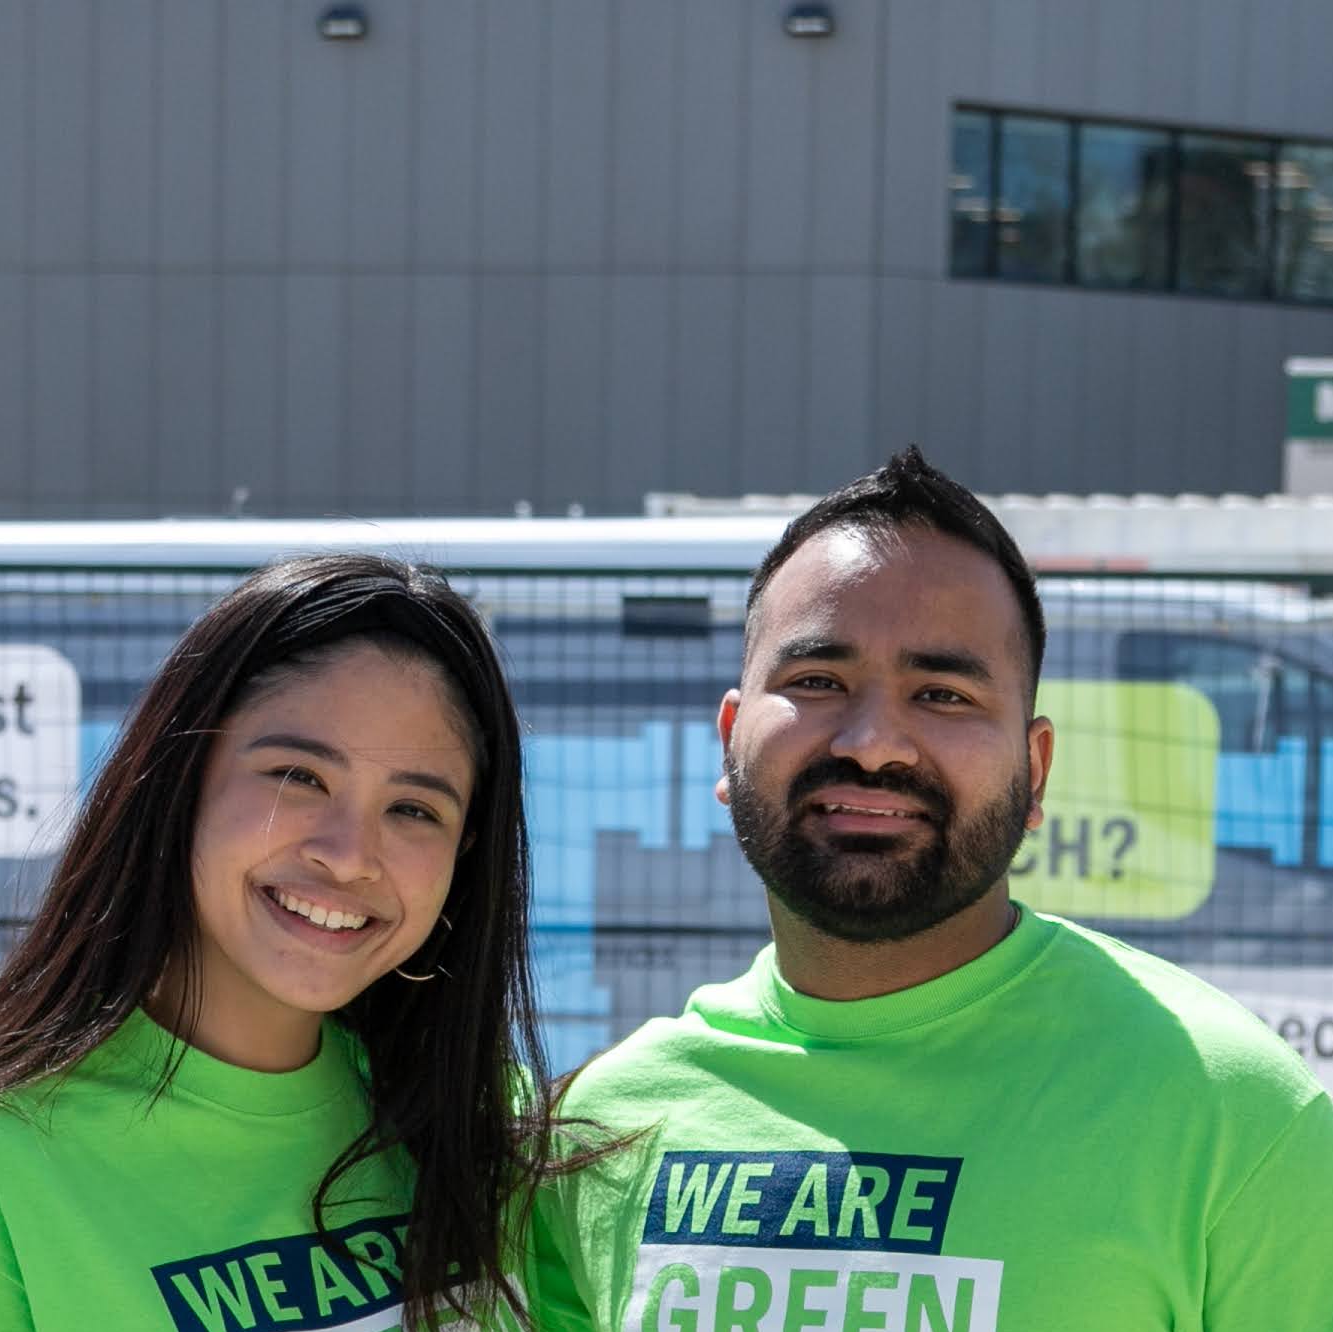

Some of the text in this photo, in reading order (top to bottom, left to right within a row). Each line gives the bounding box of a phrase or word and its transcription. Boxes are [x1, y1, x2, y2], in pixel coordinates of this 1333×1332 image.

[664, 1162, 949, 1243] WE ARE
[309, 1226, 436, 1318] AR
